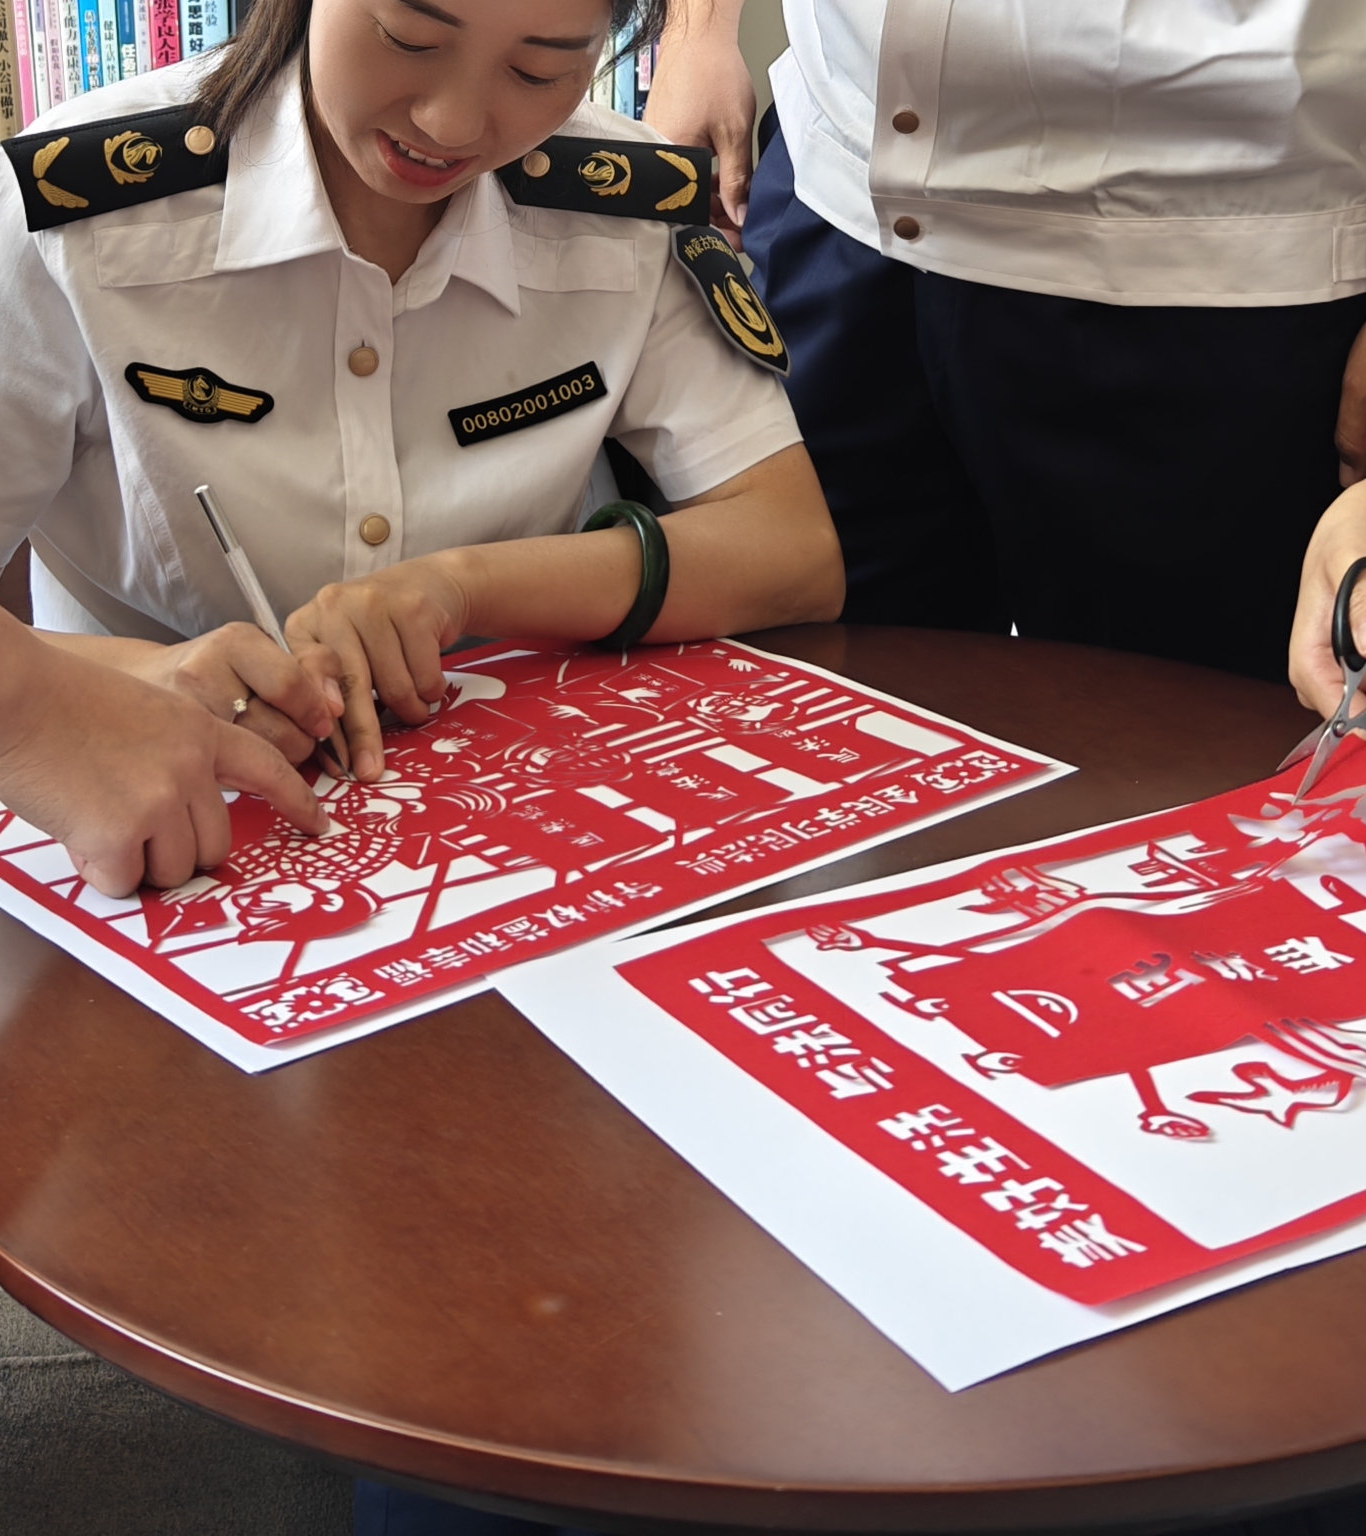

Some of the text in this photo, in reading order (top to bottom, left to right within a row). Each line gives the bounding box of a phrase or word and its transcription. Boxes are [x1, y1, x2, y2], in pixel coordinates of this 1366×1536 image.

[462, 374, 596, 434] 00802001003
[675, 784, 920, 877] 全民学习民法典
[373, 880, 663, 986] 守护权益和幸福
[688, 967, 1148, 1268] 美好生活 与法同行
